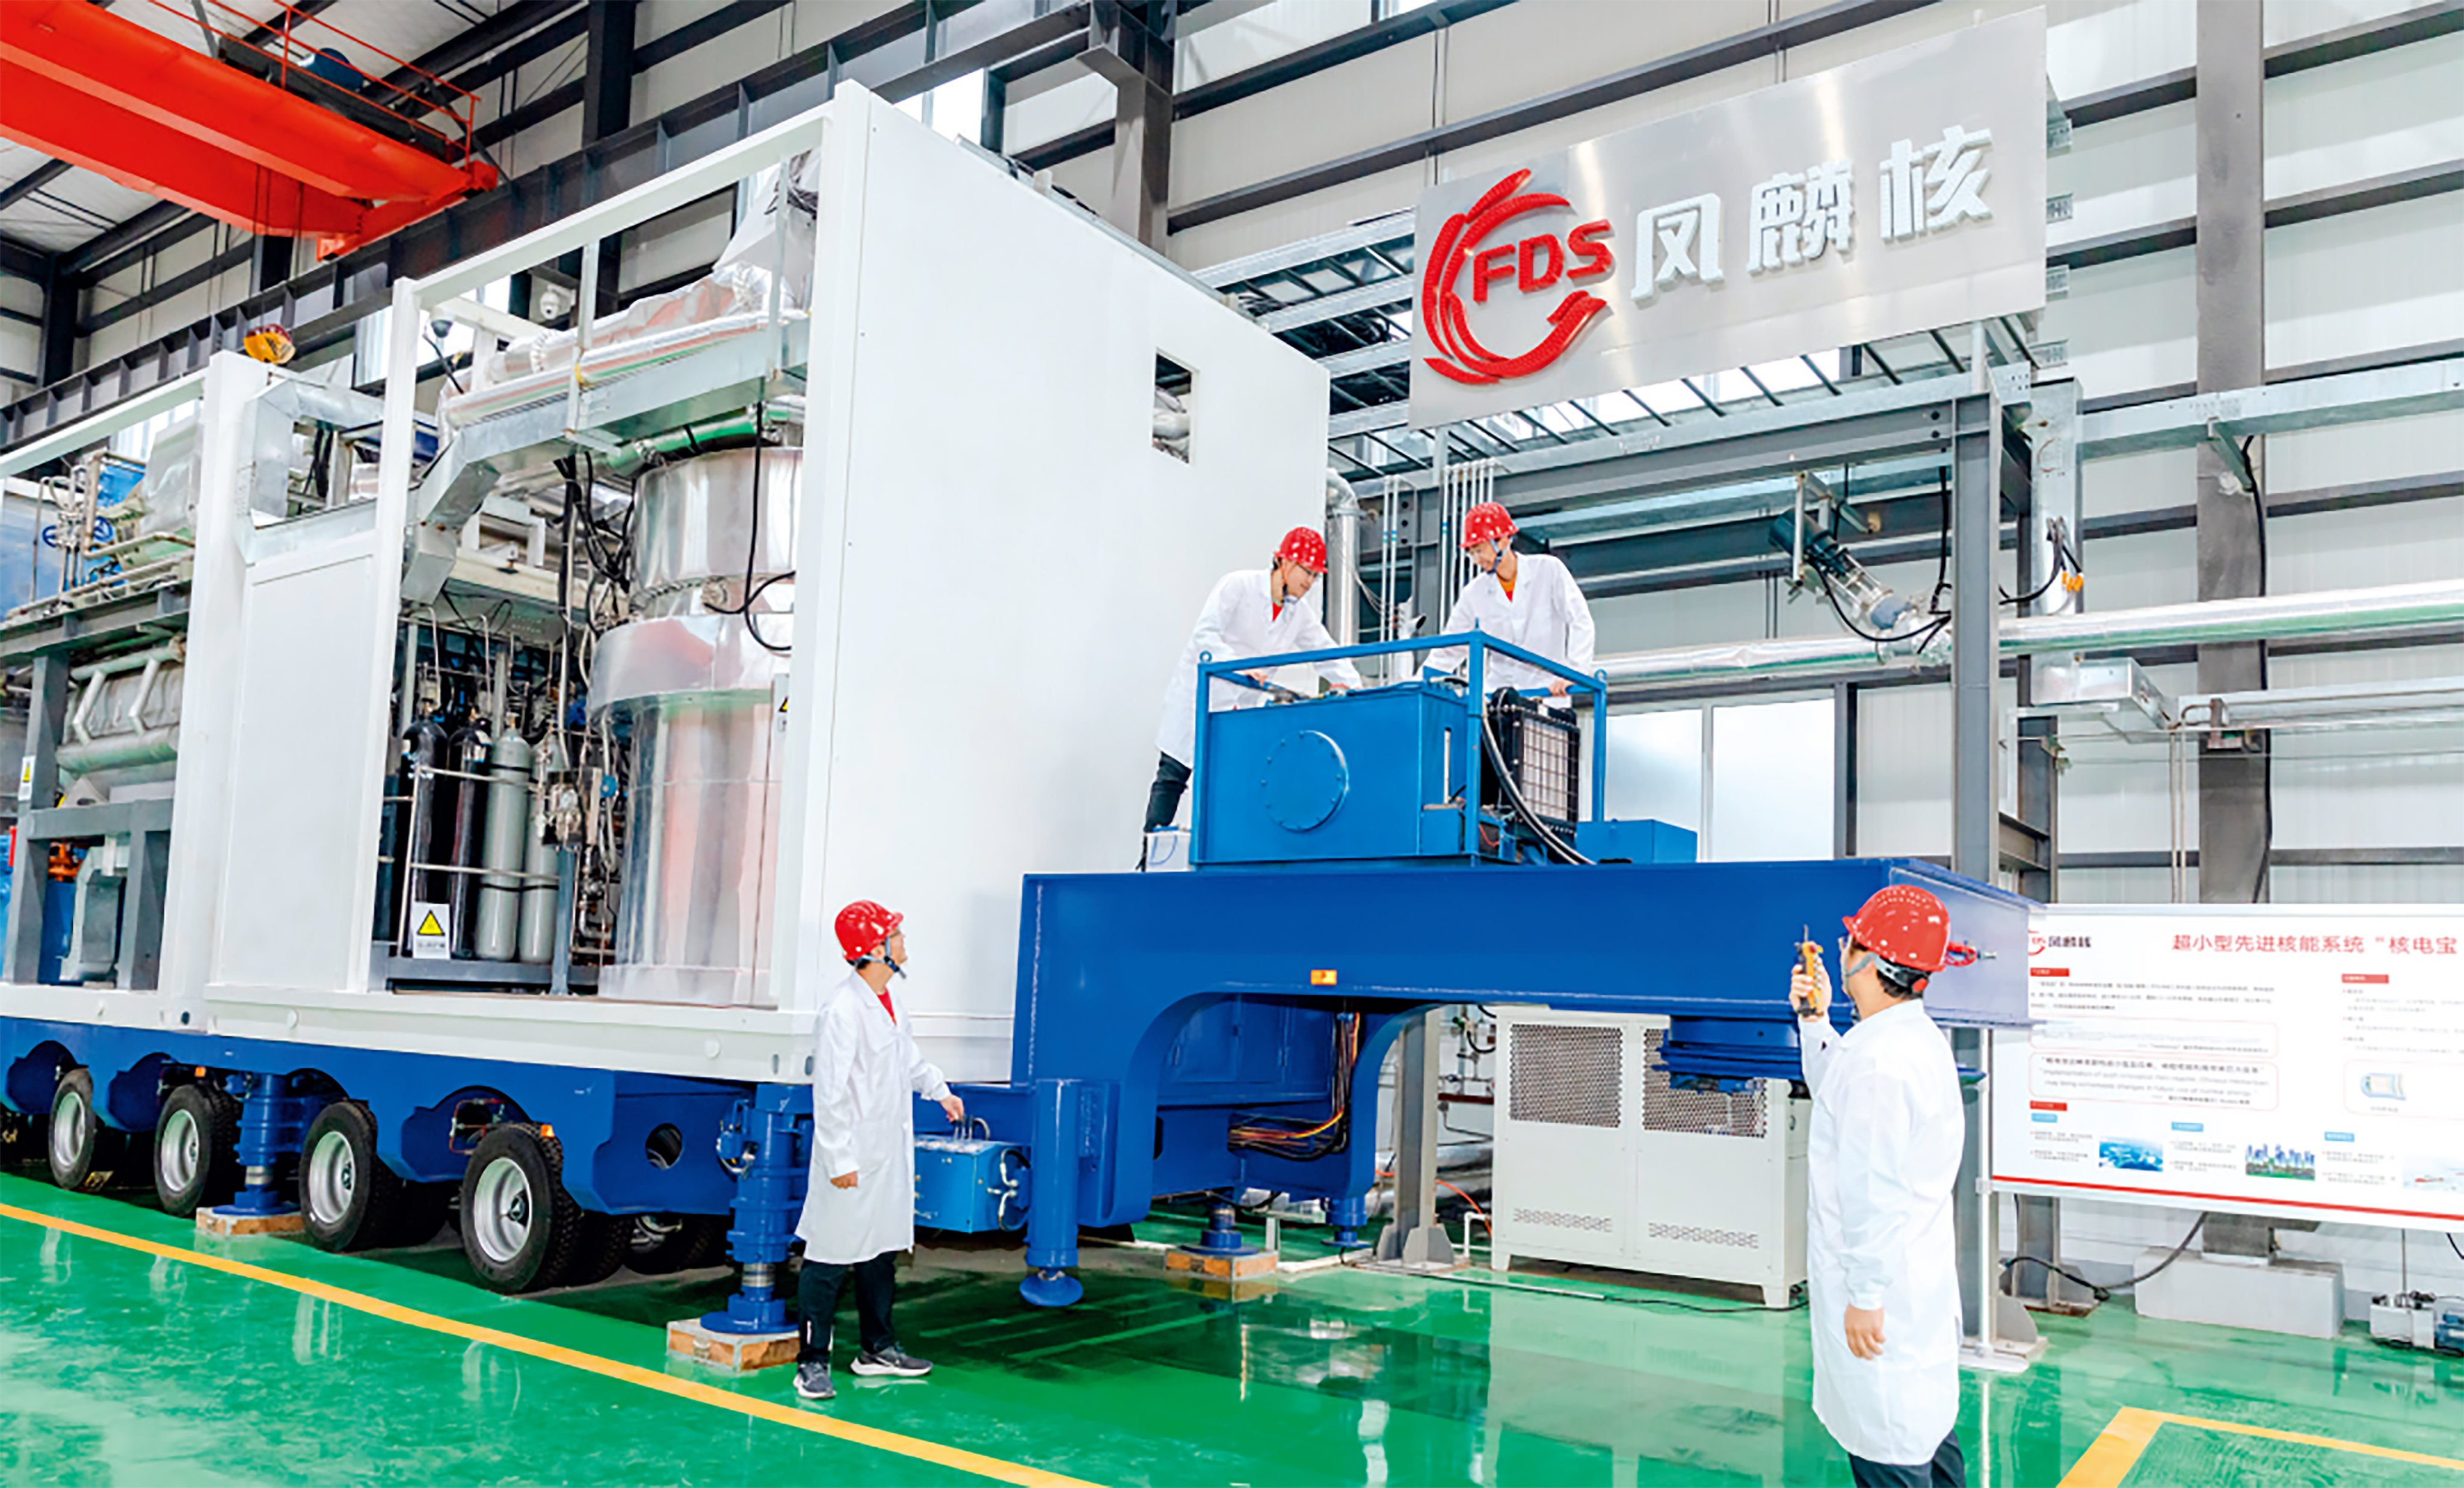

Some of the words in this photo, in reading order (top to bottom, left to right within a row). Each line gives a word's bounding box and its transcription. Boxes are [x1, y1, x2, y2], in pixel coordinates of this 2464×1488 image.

[1473, 218, 1613, 305] FDS
[1630, 125, 1993, 302] 凤麟核
